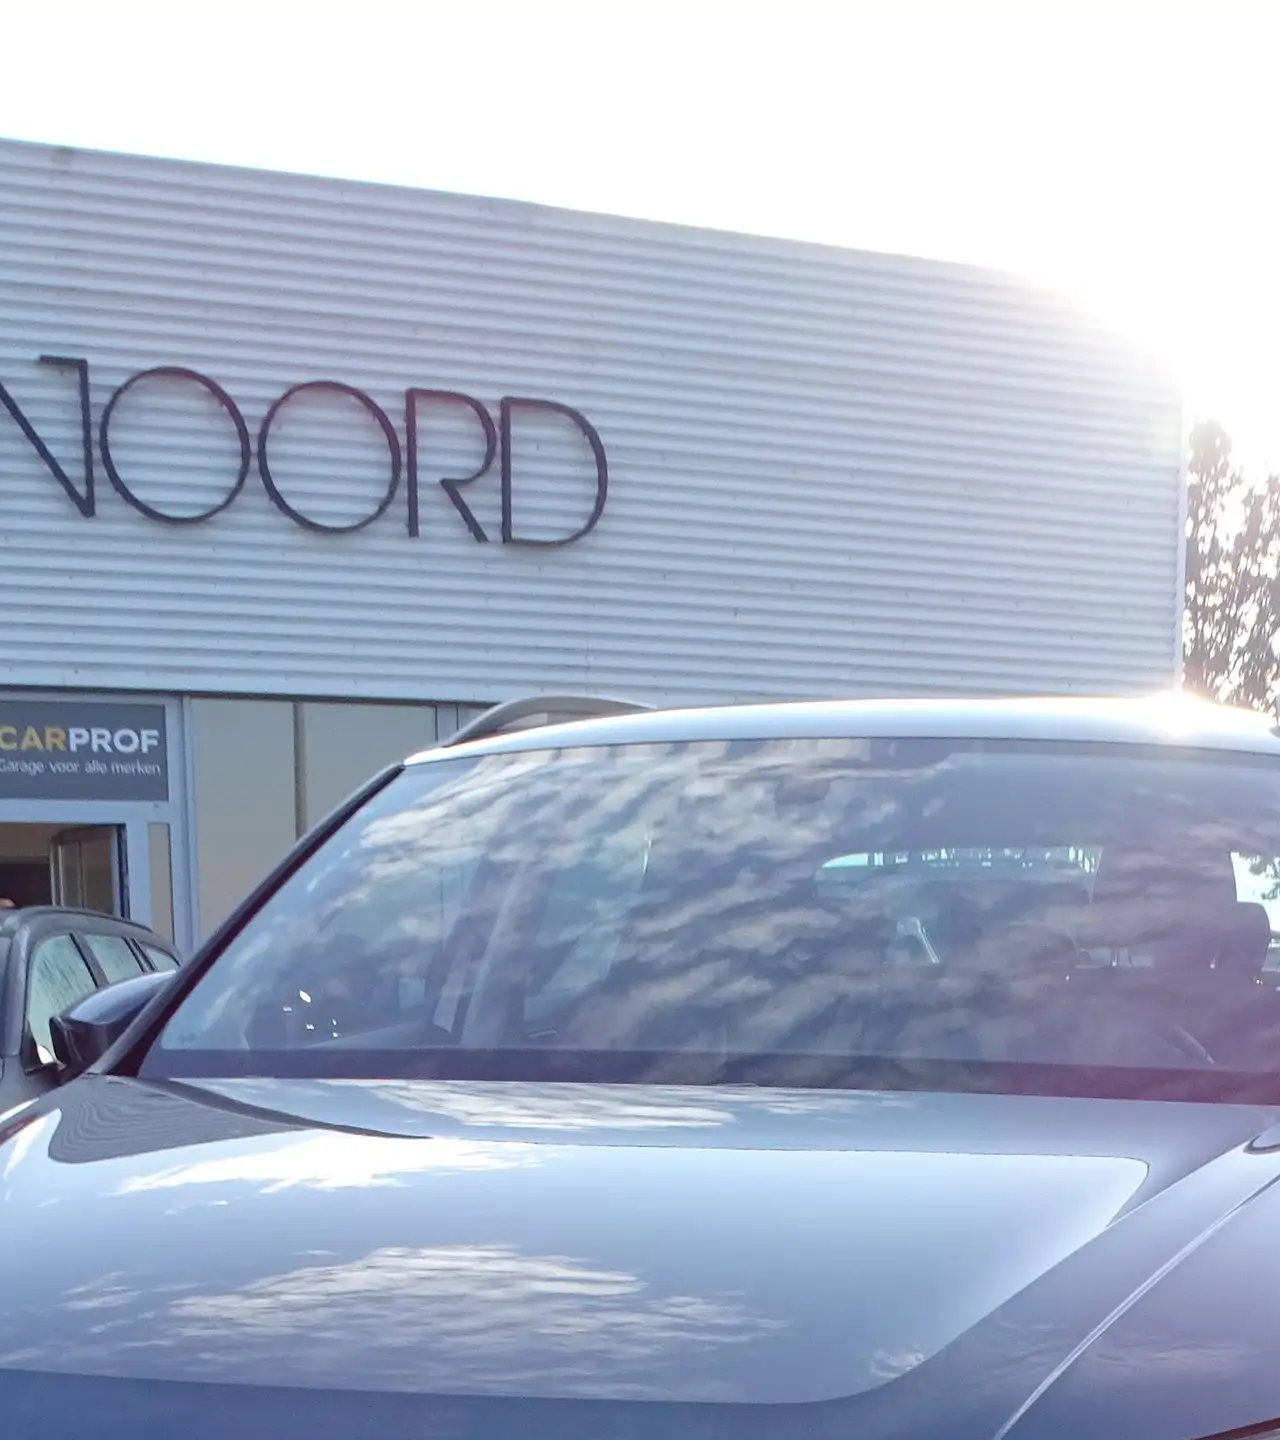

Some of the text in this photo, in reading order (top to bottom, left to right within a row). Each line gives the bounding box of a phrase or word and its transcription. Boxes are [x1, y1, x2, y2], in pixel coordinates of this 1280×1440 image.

[49, 760, 80, 774] voor
[84, 758, 108, 775] alle
[111, 760, 162, 776] merken
